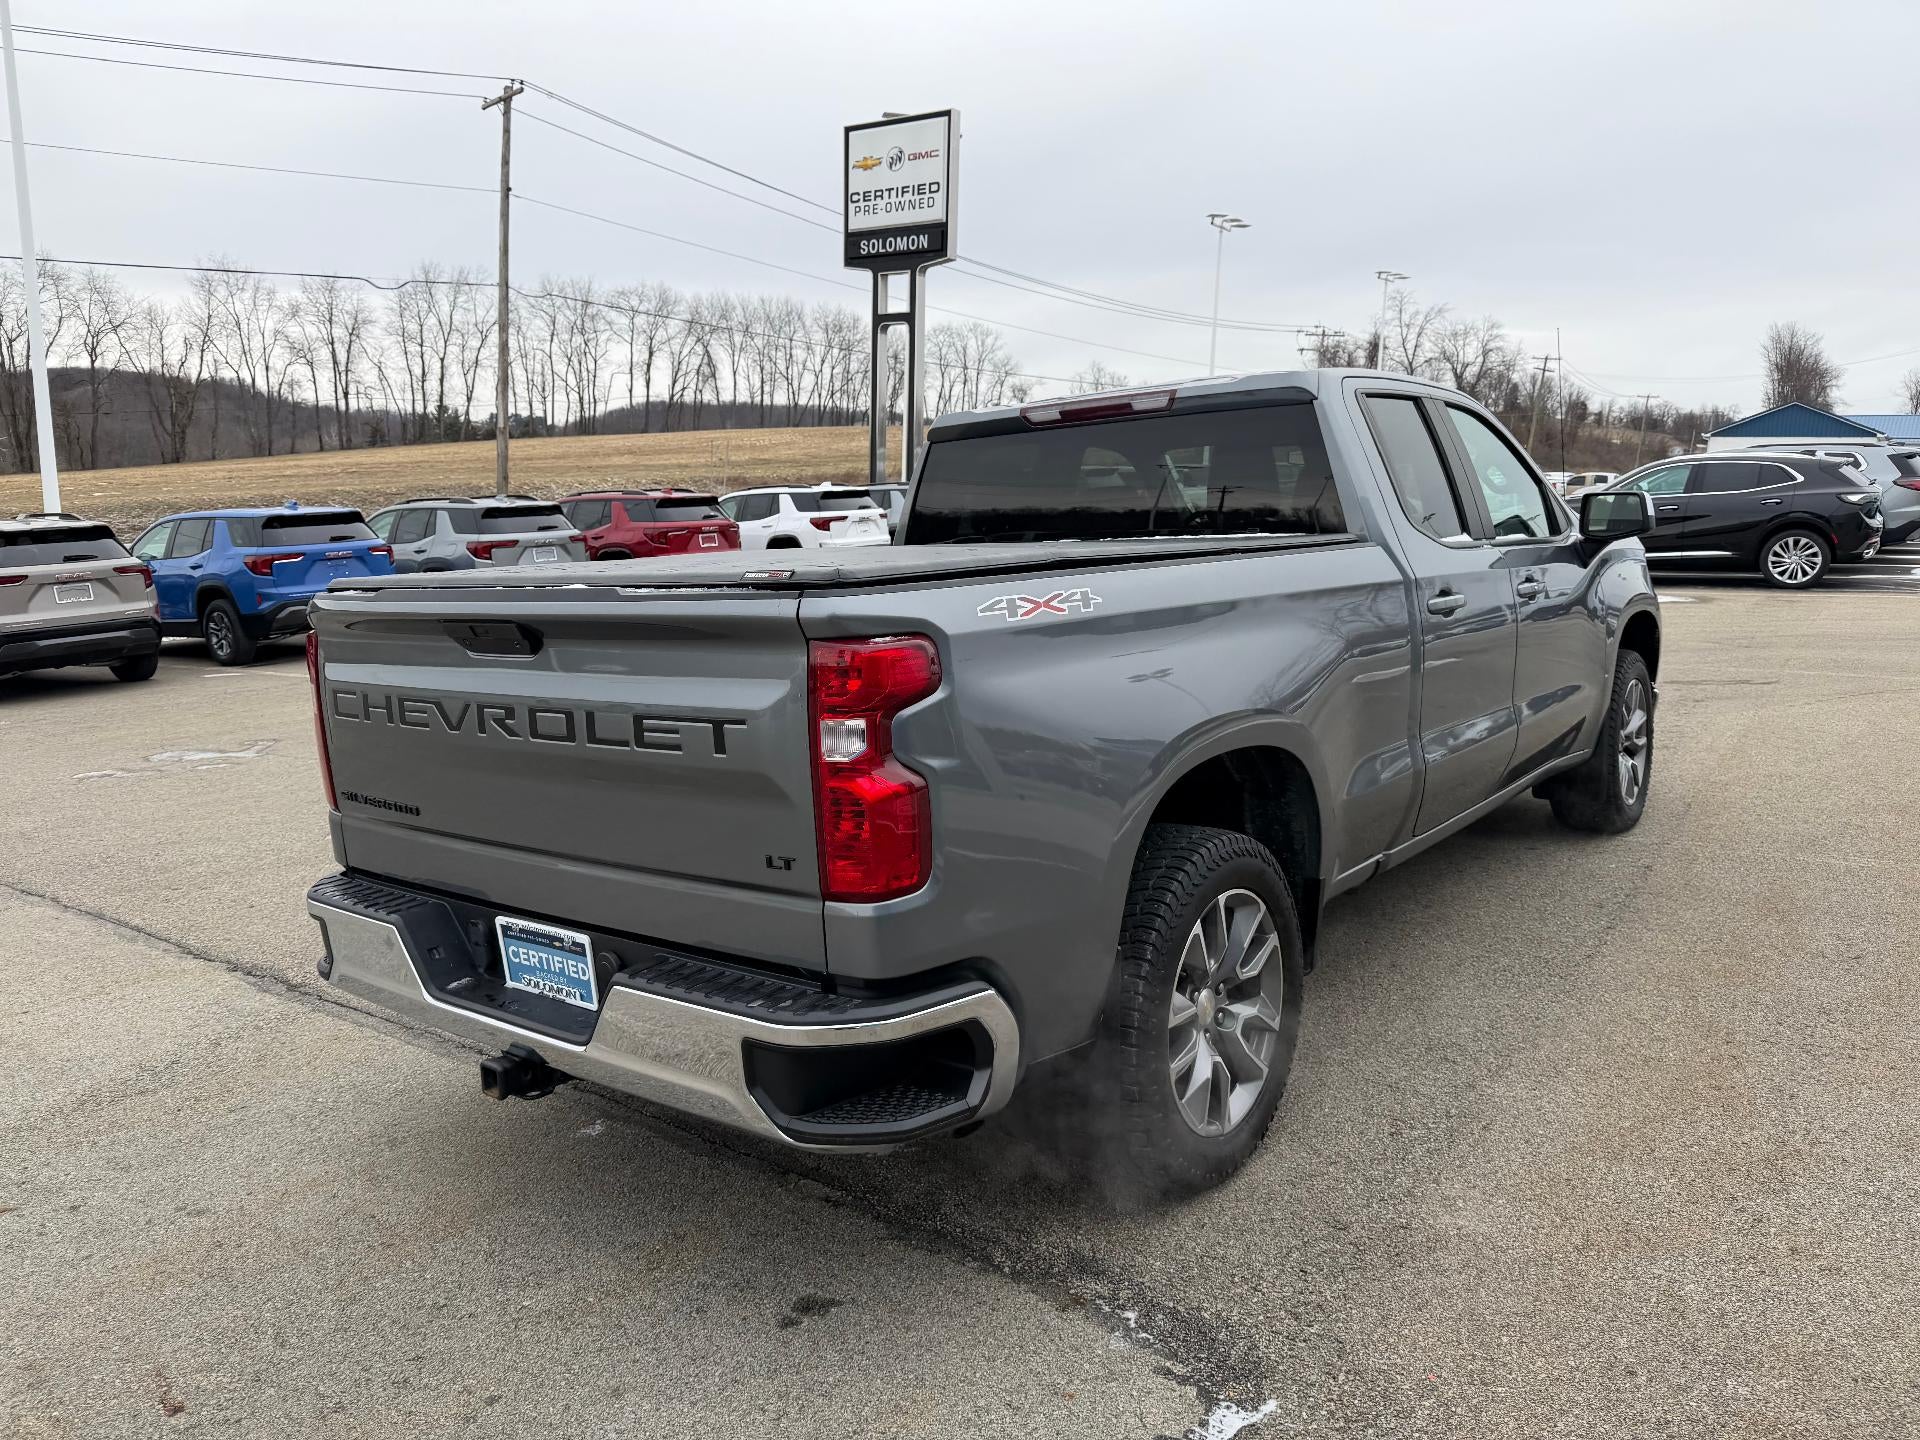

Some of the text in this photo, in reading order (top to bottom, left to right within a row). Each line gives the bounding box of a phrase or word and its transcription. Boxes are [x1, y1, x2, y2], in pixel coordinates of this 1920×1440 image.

[908, 149, 940, 161] GMC
[850, 181, 940, 203] CERTIFIED
[854, 197, 935, 217] PRE-OWNED
[860, 234, 928, 255] SOLOMON
[333, 689, 748, 758] CHEVROLET
[341, 791, 421, 816] SILVERADO
[765, 854, 796, 871] LT
[508, 945, 590, 981] CERTIFIED
[522, 976, 578, 1001] SOLOMON
